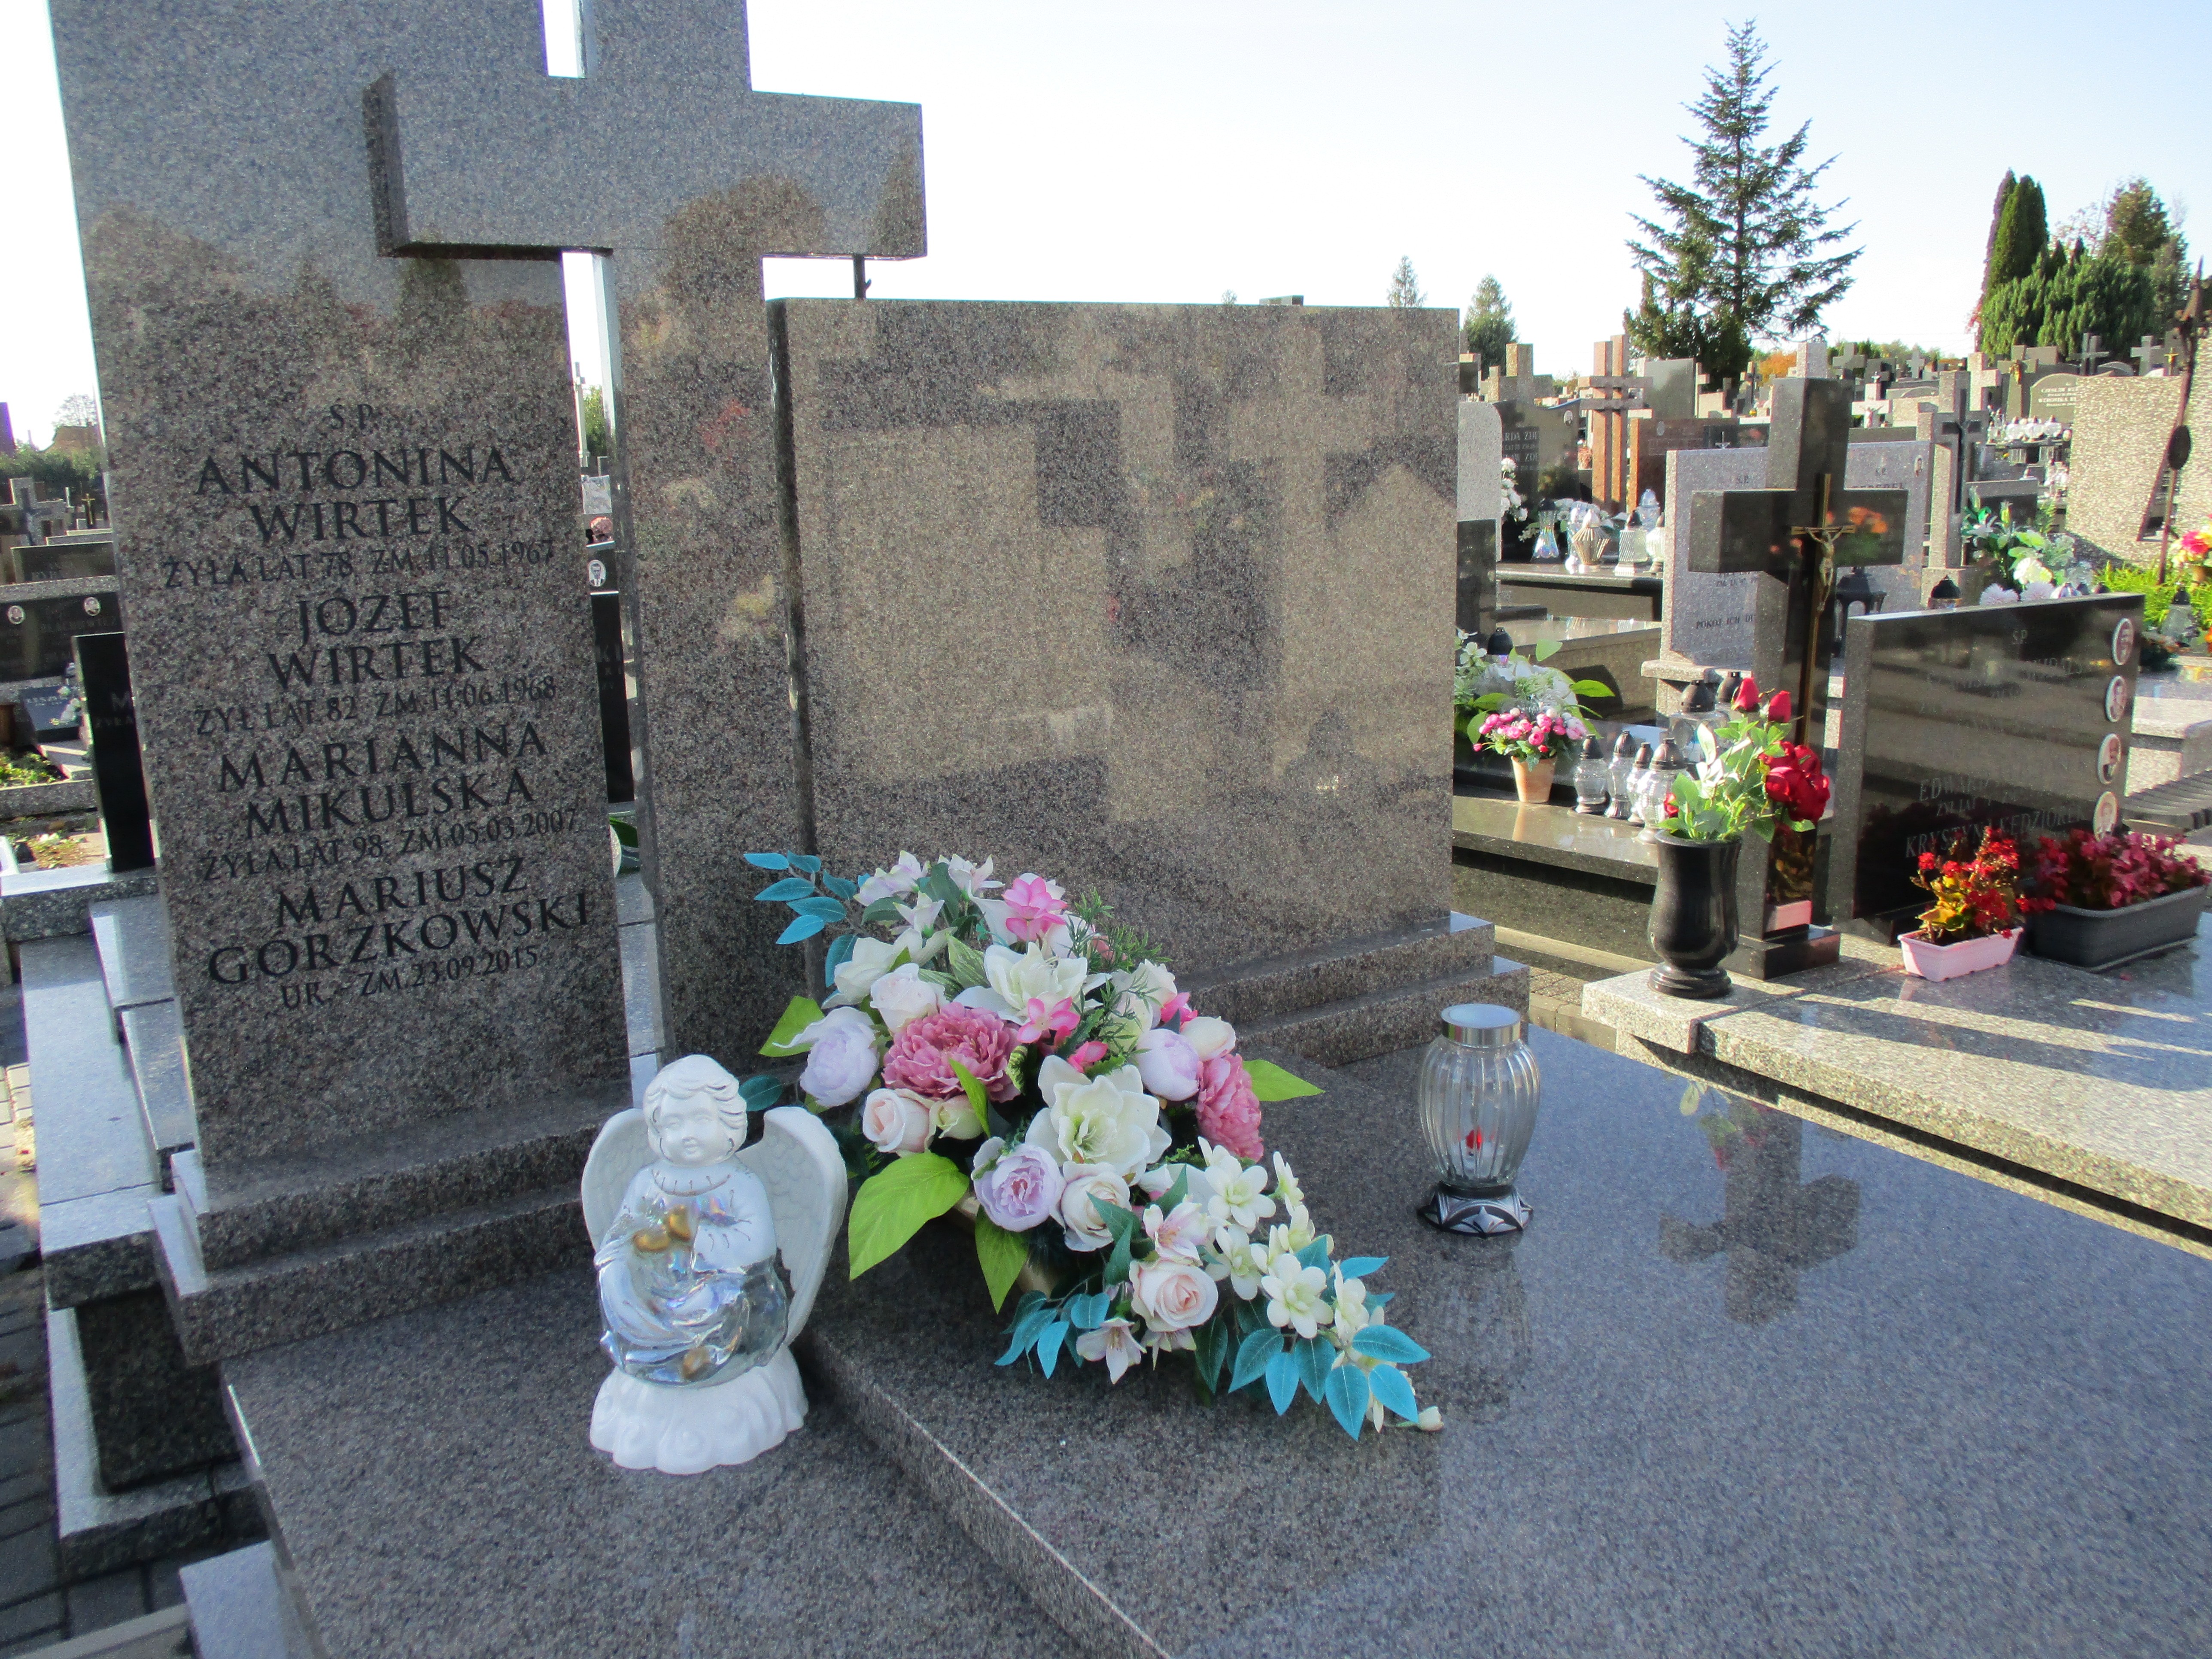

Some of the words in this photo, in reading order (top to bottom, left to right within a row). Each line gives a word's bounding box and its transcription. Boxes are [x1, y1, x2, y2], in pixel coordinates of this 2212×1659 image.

[197, 445, 514, 495] ANTONINA
[249, 496, 473, 544] WIRTEK
[258, 554, 311, 582] LAT
[295, 586, 451, 649] JÓZEF
[269, 636, 485, 689] WIRTEK
[264, 699, 317, 729] LAT
[326, 696, 358, 722] 82
[219, 722, 547, 792] MARIANNA
[246, 769, 535, 839] MIKULSKA
[290, 838, 344, 868] LAT
[352, 834, 383, 858] 98
[276, 857, 528, 927] MARIUSZ
[412, 945, 538, 987] 23.09.2015
